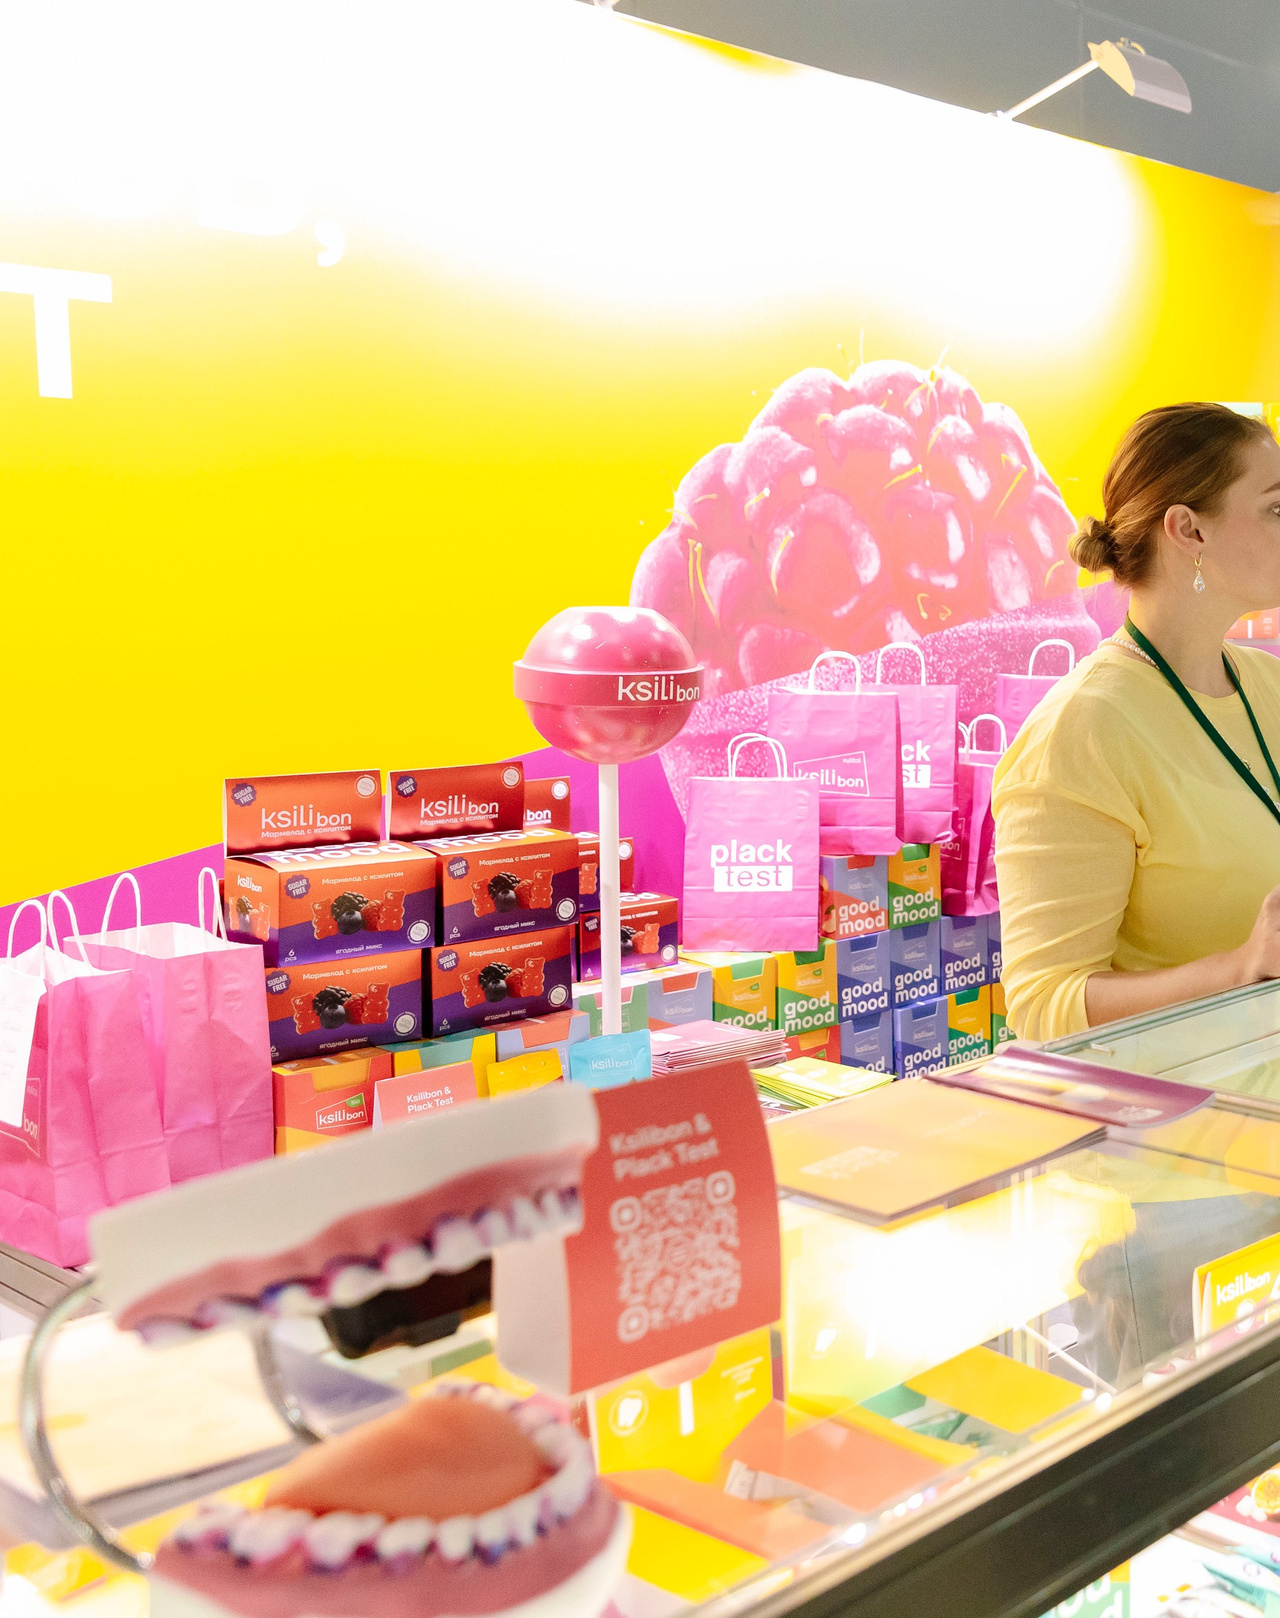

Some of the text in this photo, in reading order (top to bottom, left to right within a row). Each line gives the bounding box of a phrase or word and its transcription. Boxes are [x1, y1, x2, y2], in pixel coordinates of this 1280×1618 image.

[234, 786, 254, 801] SUGAR
[239, 794, 254, 806] FREE
[261, 829, 305, 839] Мармелад
[313, 825, 352, 835] ксилитом
[479, 857, 514, 867] Мармелад
[710, 839, 793, 869] plack
[449, 860, 467, 872] SUGAR
[453, 868, 467, 877] FREE
[287, 878, 308, 891] SUGAR
[321, 876, 362, 886] Мармелад
[369, 871, 404, 880] ксилитом
[725, 865, 783, 888] test
[292, 887, 308, 897] FREE
[892, 887, 934, 912] good
[838, 896, 880, 922] good
[893, 901, 939, 924] mood
[839, 912, 886, 935] mood
[284, 955, 298, 963] pcs
[288, 948, 295, 957] 6
[438, 953, 457, 965] SUGAR
[469, 947, 506, 958] Мармелад
[302, 970, 344, 980] Мармелад
[352, 964, 388, 974] ксилитом
[443, 960, 457, 970] FREE
[944, 953, 981, 978] good
[267, 974, 288, 987] SUGAR
[894, 964, 933, 990] good
[945, 967, 986, 991] mood
[273, 982, 287, 993] FREE
[841, 977, 883, 1004] good
[895, 978, 938, 1003] mood
[784, 991, 830, 1019] good
[842, 992, 888, 1018] mood
[785, 1007, 835, 1033] mood
[948, 1028, 984, 1054] good
[904, 1043, 942, 1070] good
[949, 1042, 989, 1066] mood
[406, 1086, 452, 1104] Ksilibon &
[407, 1097, 454, 1114] Plack Test
